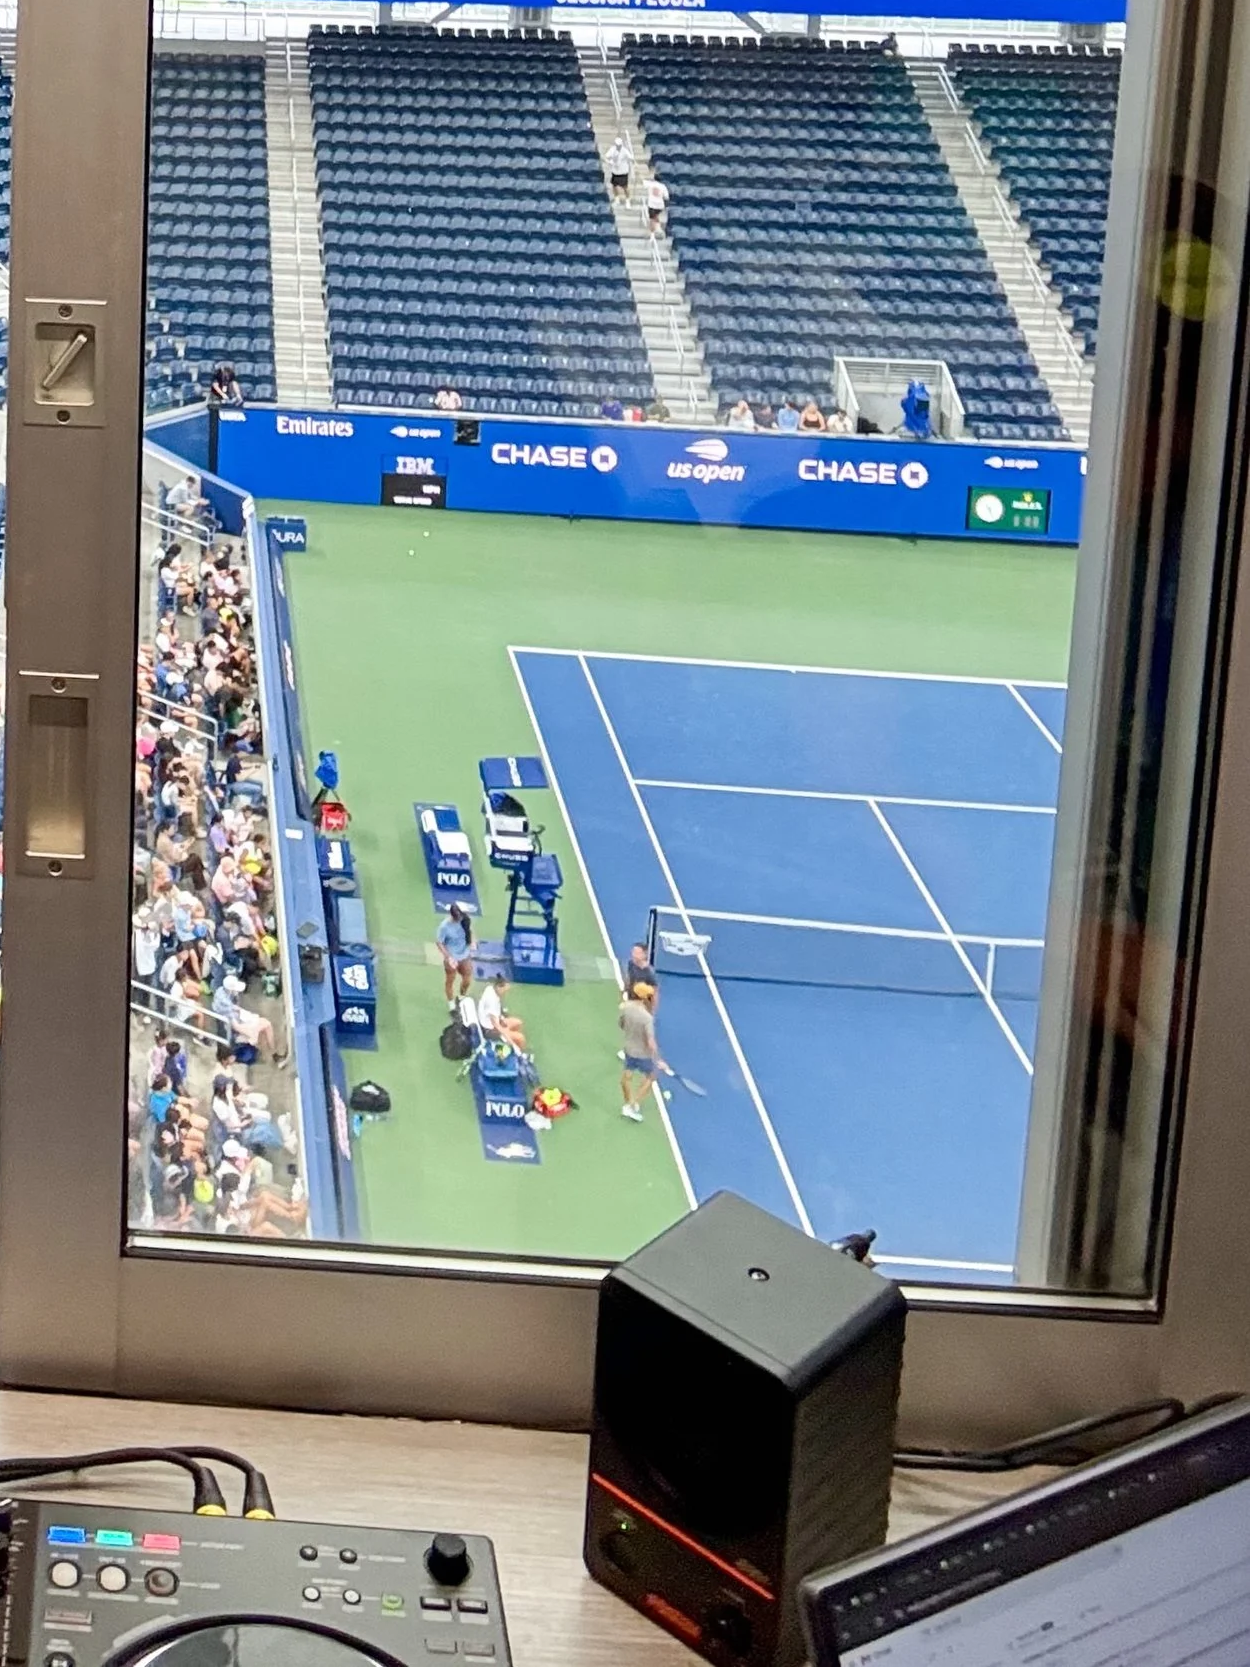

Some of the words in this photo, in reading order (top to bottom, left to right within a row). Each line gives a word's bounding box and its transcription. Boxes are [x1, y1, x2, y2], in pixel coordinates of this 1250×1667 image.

[276, 415, 354, 437] Emirates
[395, 456, 436, 475] IBM
[491, 442, 588, 469] CHASE
[666, 460, 692, 479] us
[692, 462, 746, 484] open
[798, 458, 898, 485] CHASE
[271, 528, 306, 544] URA
[437, 871, 471, 886] POLO
[485, 1100, 525, 1119] POLO
